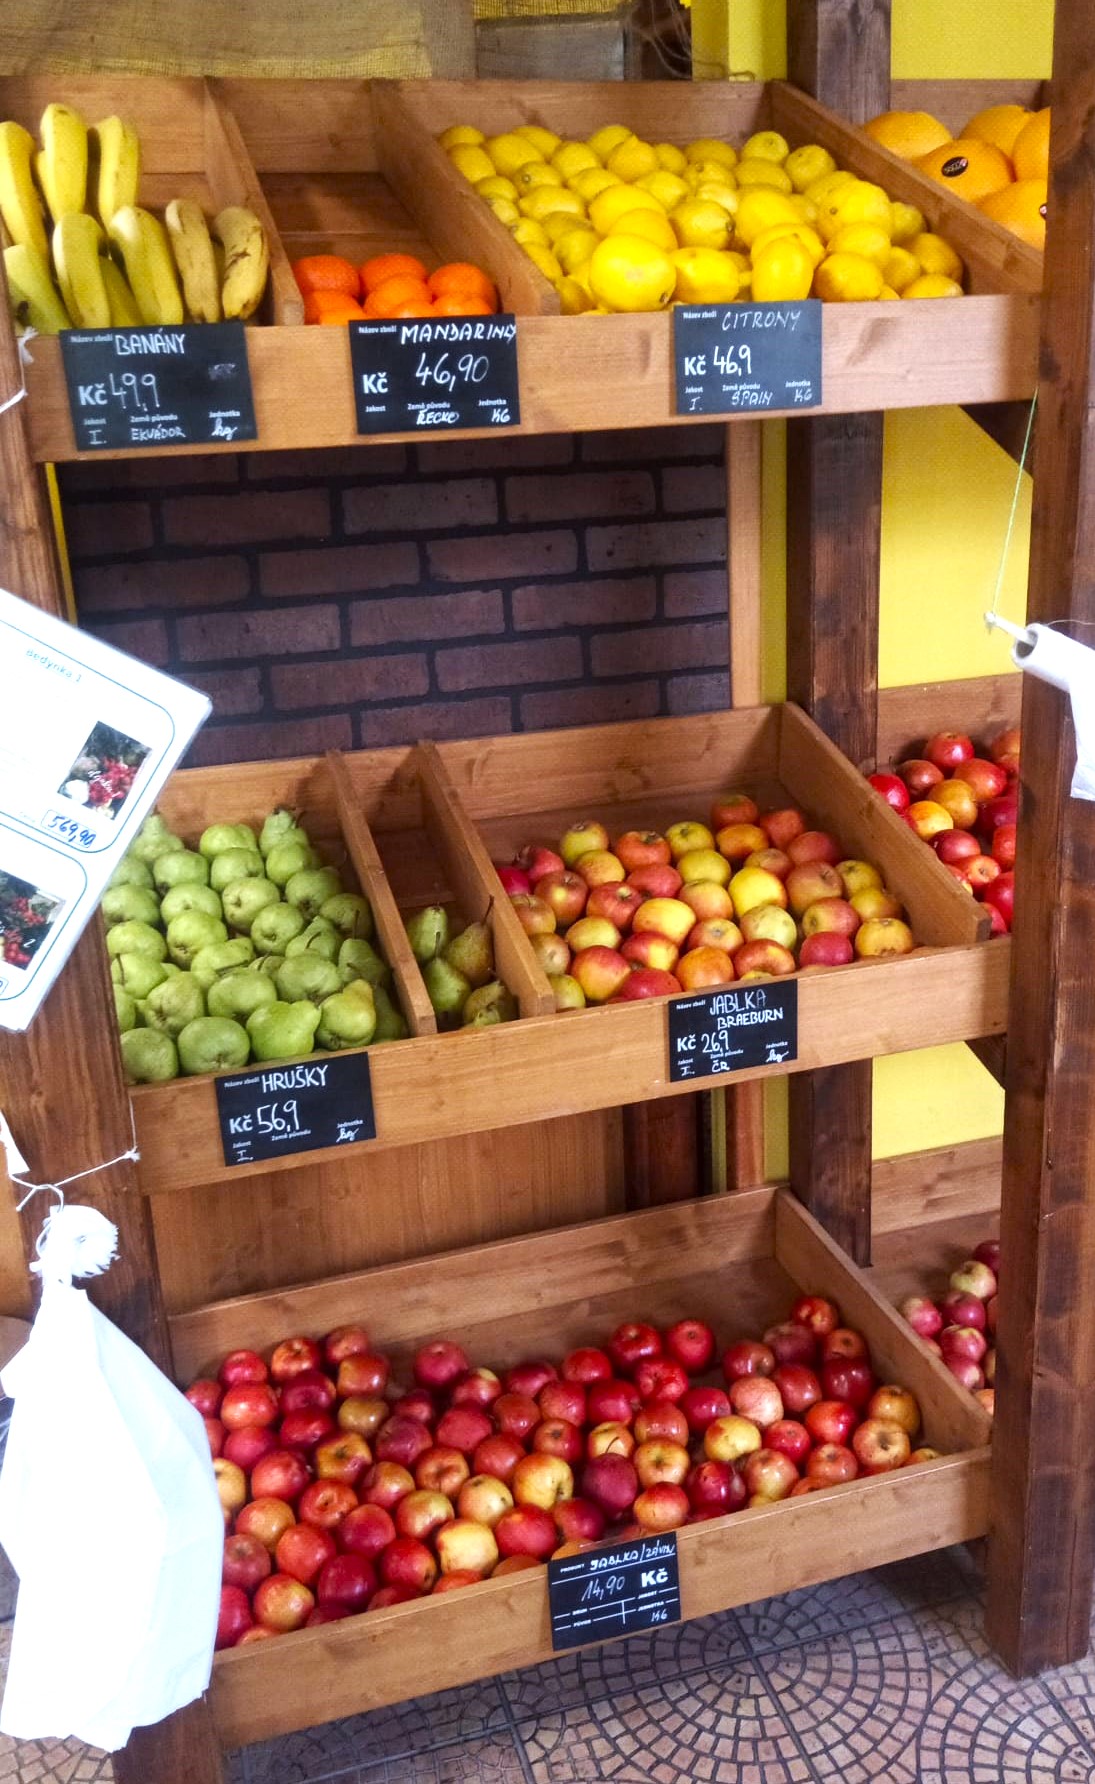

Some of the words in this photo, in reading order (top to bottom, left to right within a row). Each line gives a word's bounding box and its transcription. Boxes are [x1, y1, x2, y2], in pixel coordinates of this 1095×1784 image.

[722, 311, 800, 330] CITRONY
[115, 328, 185, 356] BANÁNY
[363, 372, 388, 393] Kč
[415, 353, 488, 392] 46,90
[684, 355, 706, 375] Kč
[713, 345, 752, 376] 46,9
[78, 384, 107, 405] Kč
[109, 373, 160, 411] 49,9
[732, 391, 773, 405] SPAIN
[48, 815, 96, 845] 569,90
[710, 989, 766, 1015] JABLKA
[718, 1007, 783, 1030] BRAEBURN
[677, 1034, 696, 1052] Kč
[261, 1065, 328, 1093] HRUŠKY
[712, 1060, 730, 1072] ČR
[229, 1114, 253, 1134] Kč
[257, 1100, 300, 1134] 56,9
[581, 1576, 625, 1601] 14,90
[641, 1568, 668, 1588] Kč
